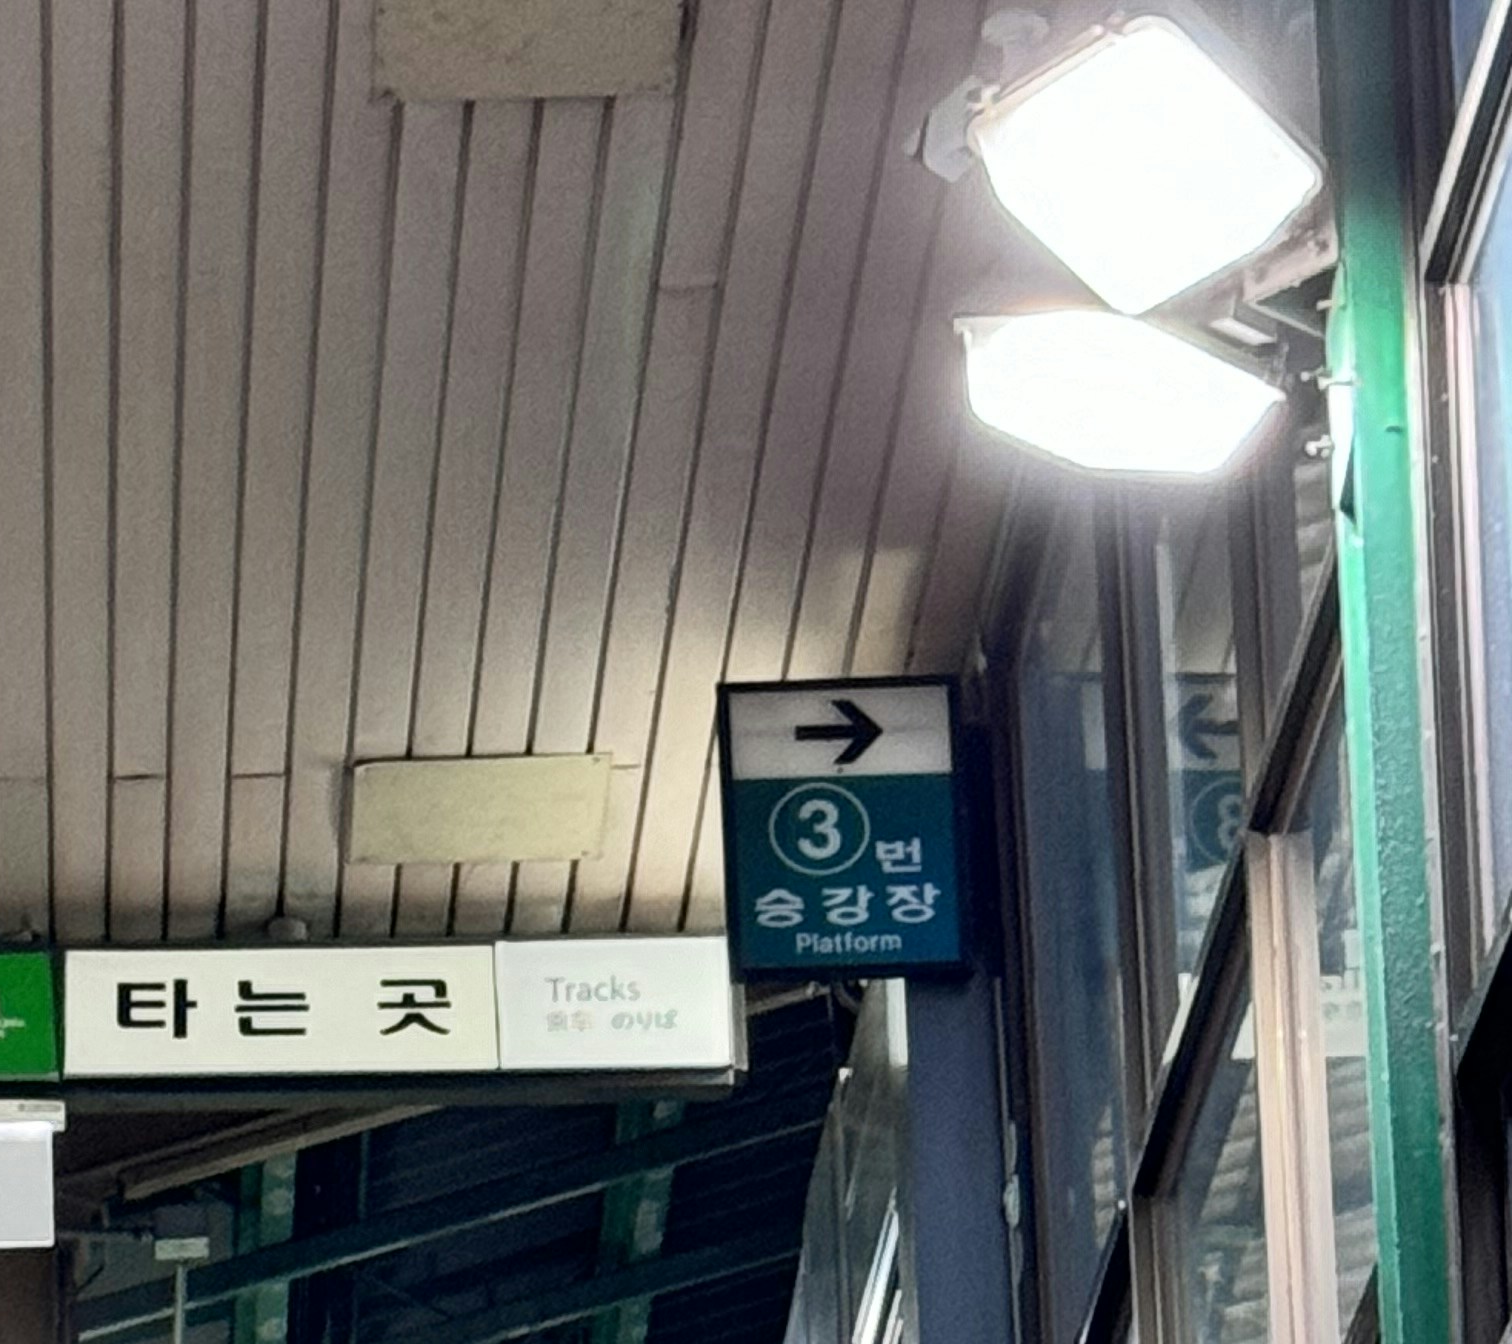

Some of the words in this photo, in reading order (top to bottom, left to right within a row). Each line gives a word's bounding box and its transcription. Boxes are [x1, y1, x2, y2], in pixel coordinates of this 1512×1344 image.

[795, 932, 902, 954] Platform
[544, 974, 641, 1002] Tracks
[116, 978, 309, 1039] 타는
[378, 979, 451, 1036] 곳
